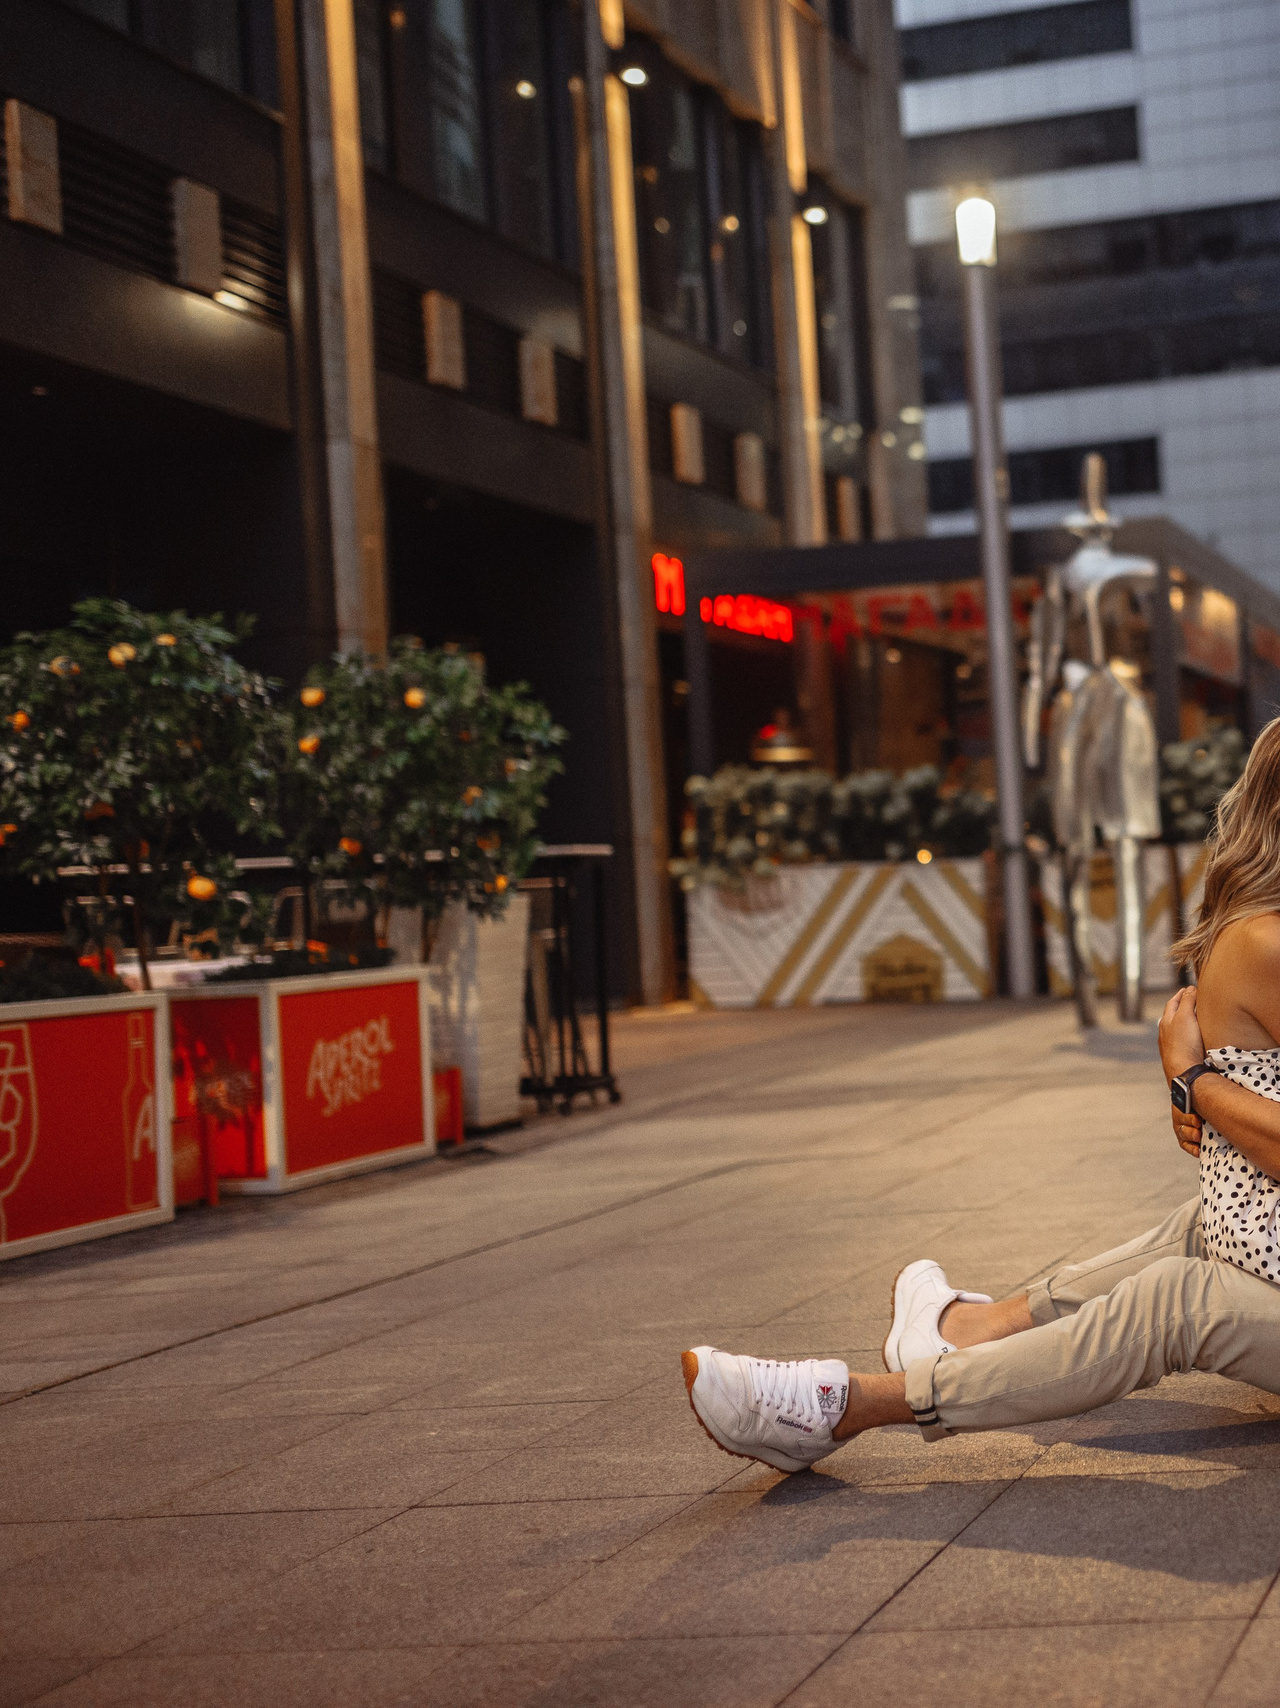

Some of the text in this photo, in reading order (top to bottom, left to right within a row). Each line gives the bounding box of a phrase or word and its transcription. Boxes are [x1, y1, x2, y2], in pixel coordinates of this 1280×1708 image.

[306, 1014, 394, 1098] APEROL
[839, 1385, 848, 1412] Reebok
[775, 1416, 804, 1430] Reebok
